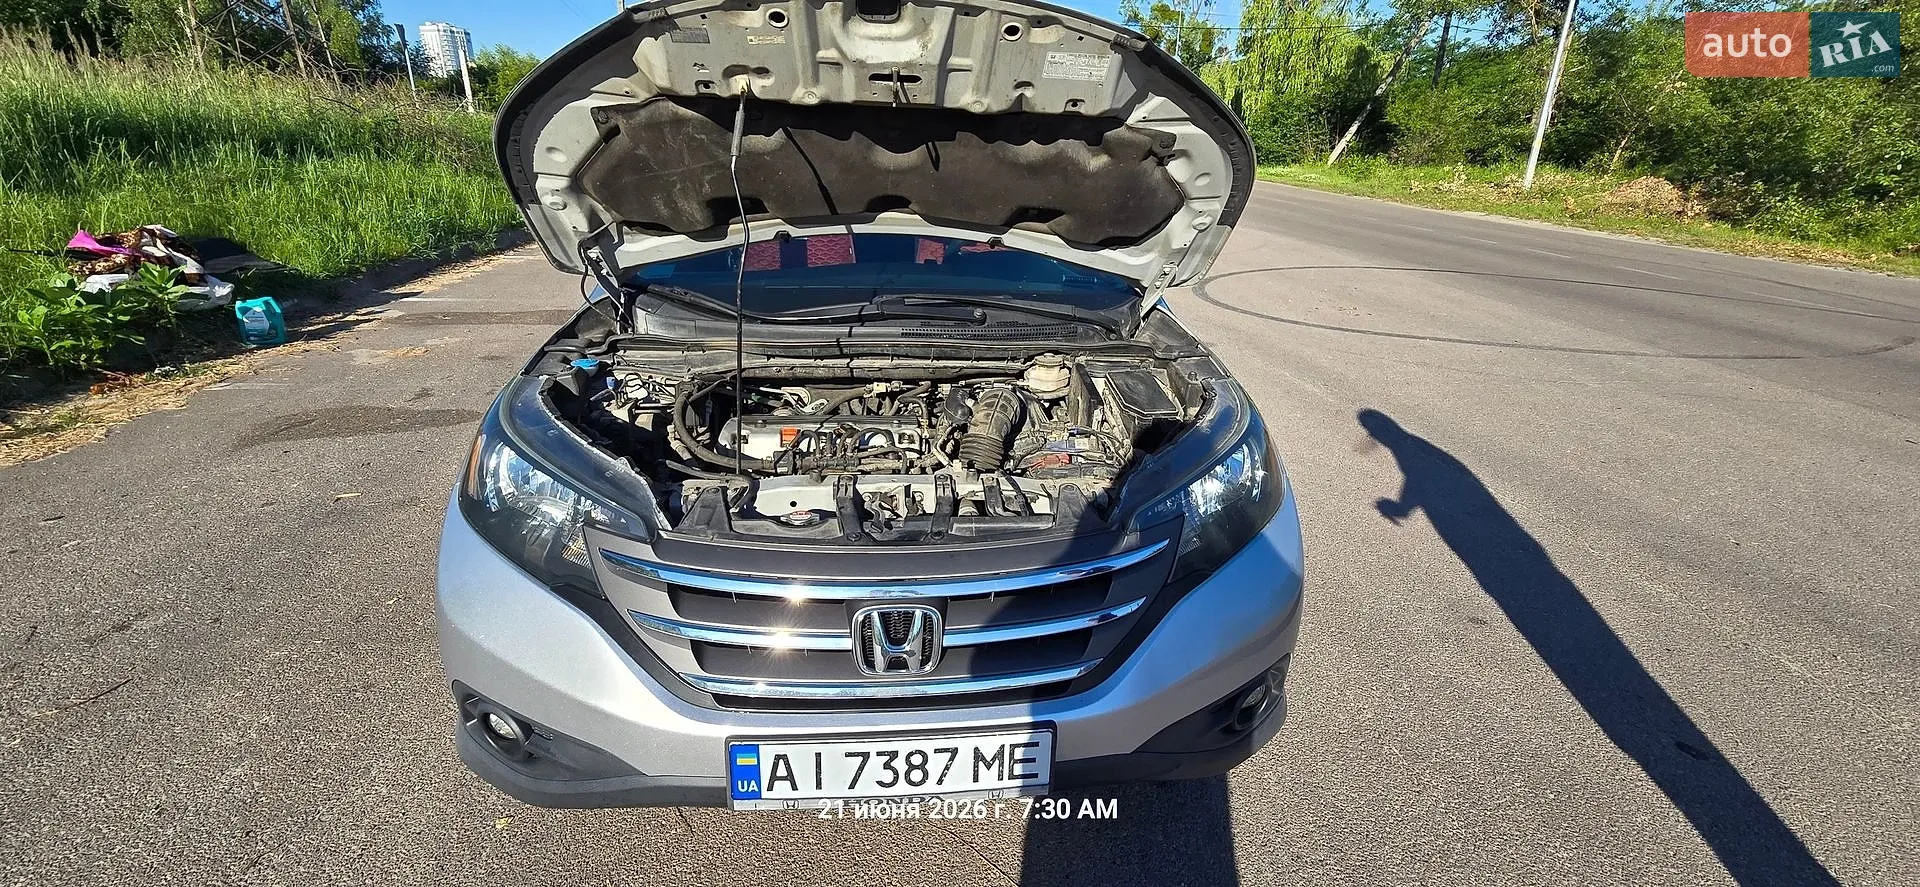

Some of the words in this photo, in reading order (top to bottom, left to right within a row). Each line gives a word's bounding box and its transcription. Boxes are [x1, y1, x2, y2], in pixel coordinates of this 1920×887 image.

[844, 746, 959, 790] 7387
[972, 740, 1040, 783] ME
[737, 780, 759, 792] UA
